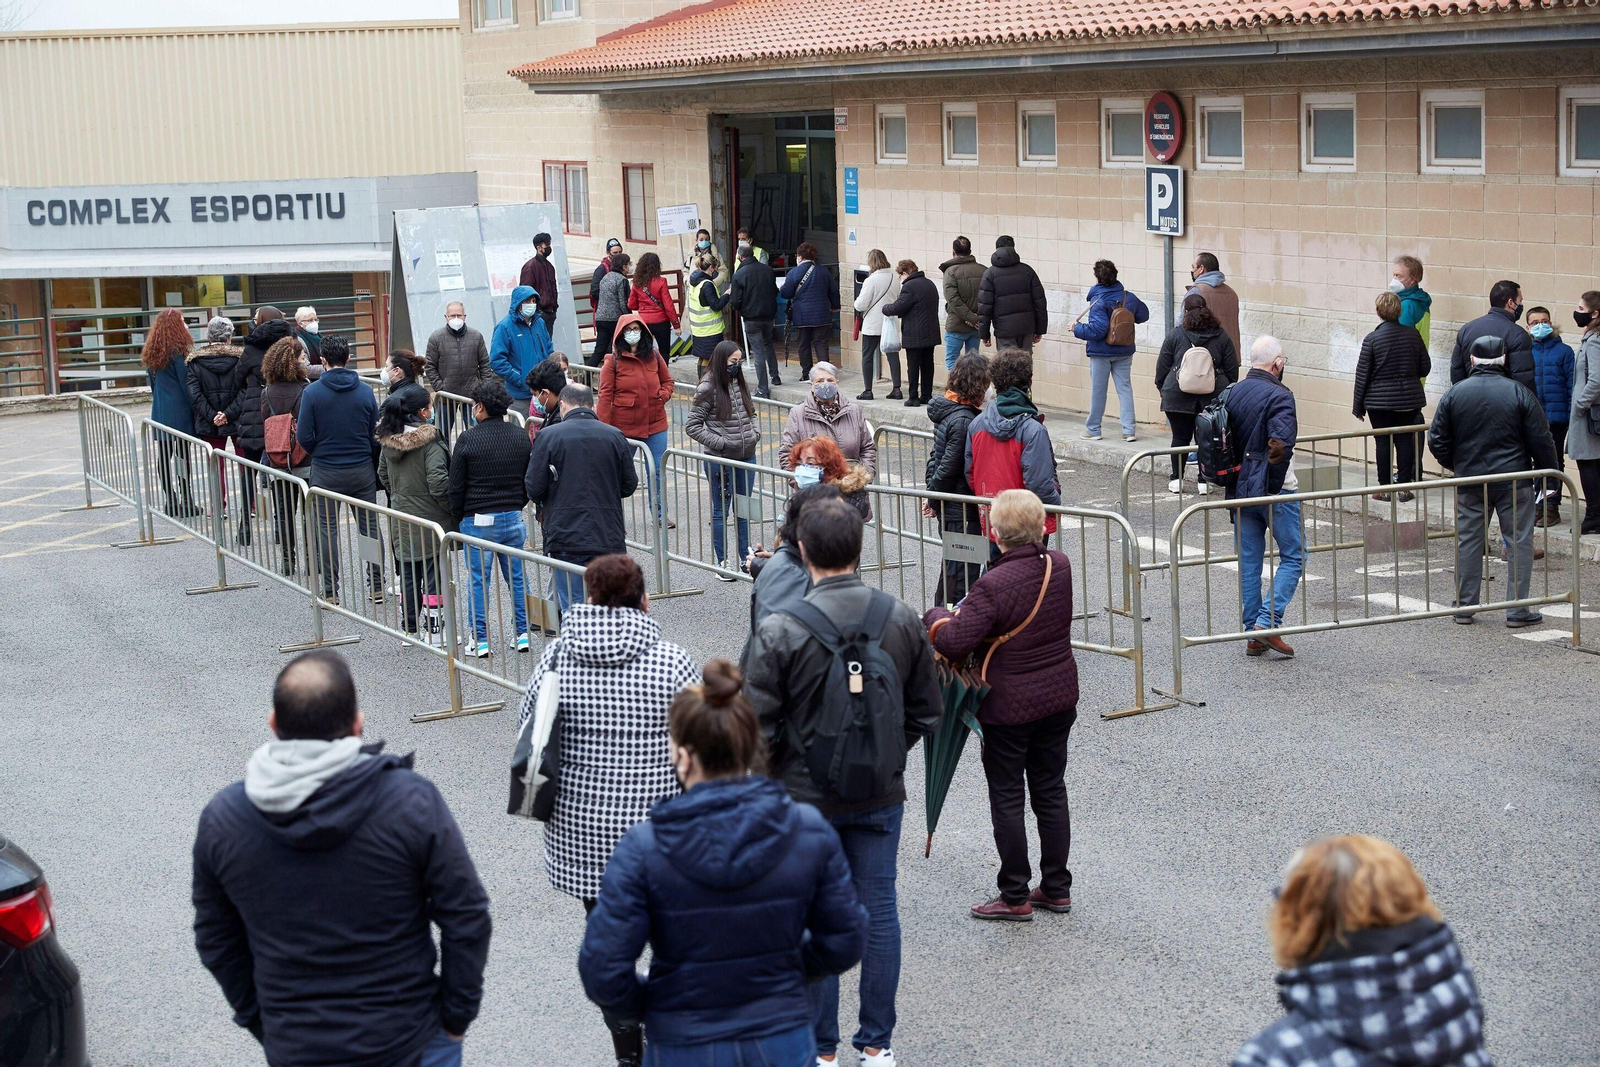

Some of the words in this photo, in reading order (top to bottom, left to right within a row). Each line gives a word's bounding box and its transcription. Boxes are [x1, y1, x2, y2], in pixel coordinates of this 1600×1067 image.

[27, 196, 171, 226] COMPLEX
[190, 192, 346, 223] ESPORTIU
[1151, 172, 1174, 226] P
[1159, 216, 1178, 228] MOTOS
